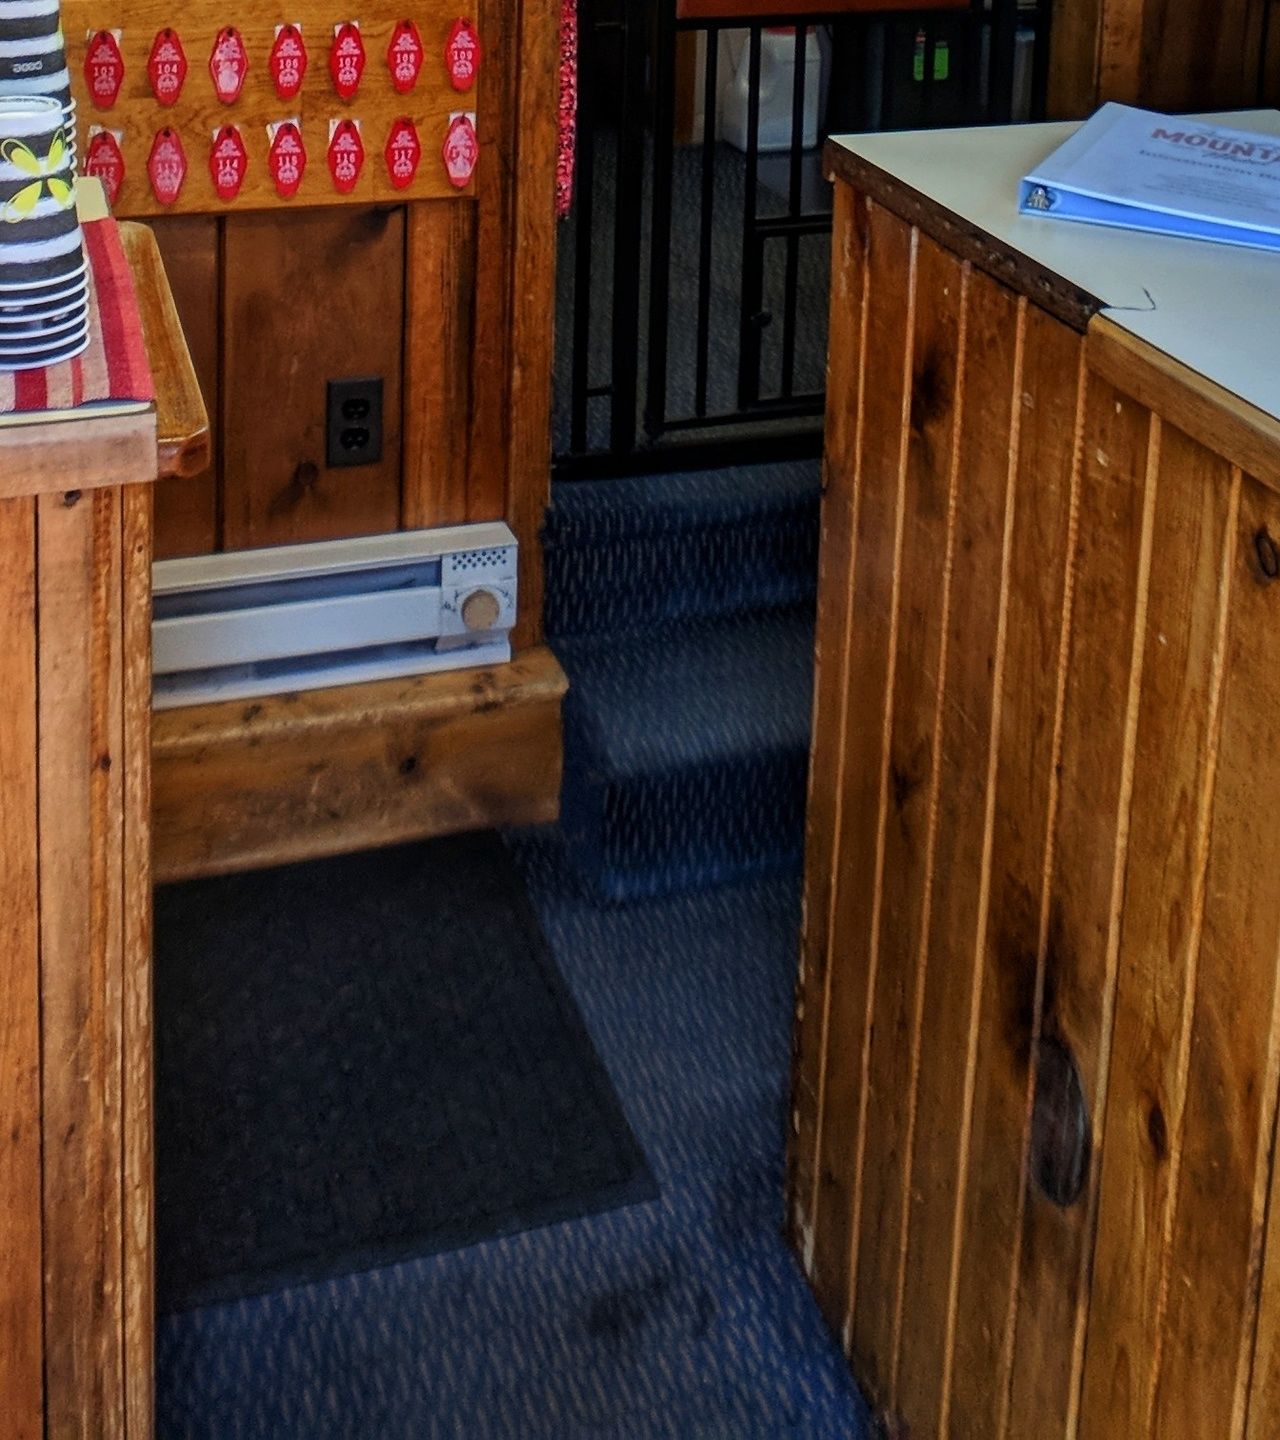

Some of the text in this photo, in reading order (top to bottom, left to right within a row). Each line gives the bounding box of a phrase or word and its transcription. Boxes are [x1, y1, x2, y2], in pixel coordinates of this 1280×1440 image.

[452, 49, 473, 61] 109
[338, 56, 358, 68] 107
[93, 66, 115, 78] 103
[157, 63, 179, 75] 104
[393, 149, 414, 161] 117
[218, 158, 239, 170] 114
